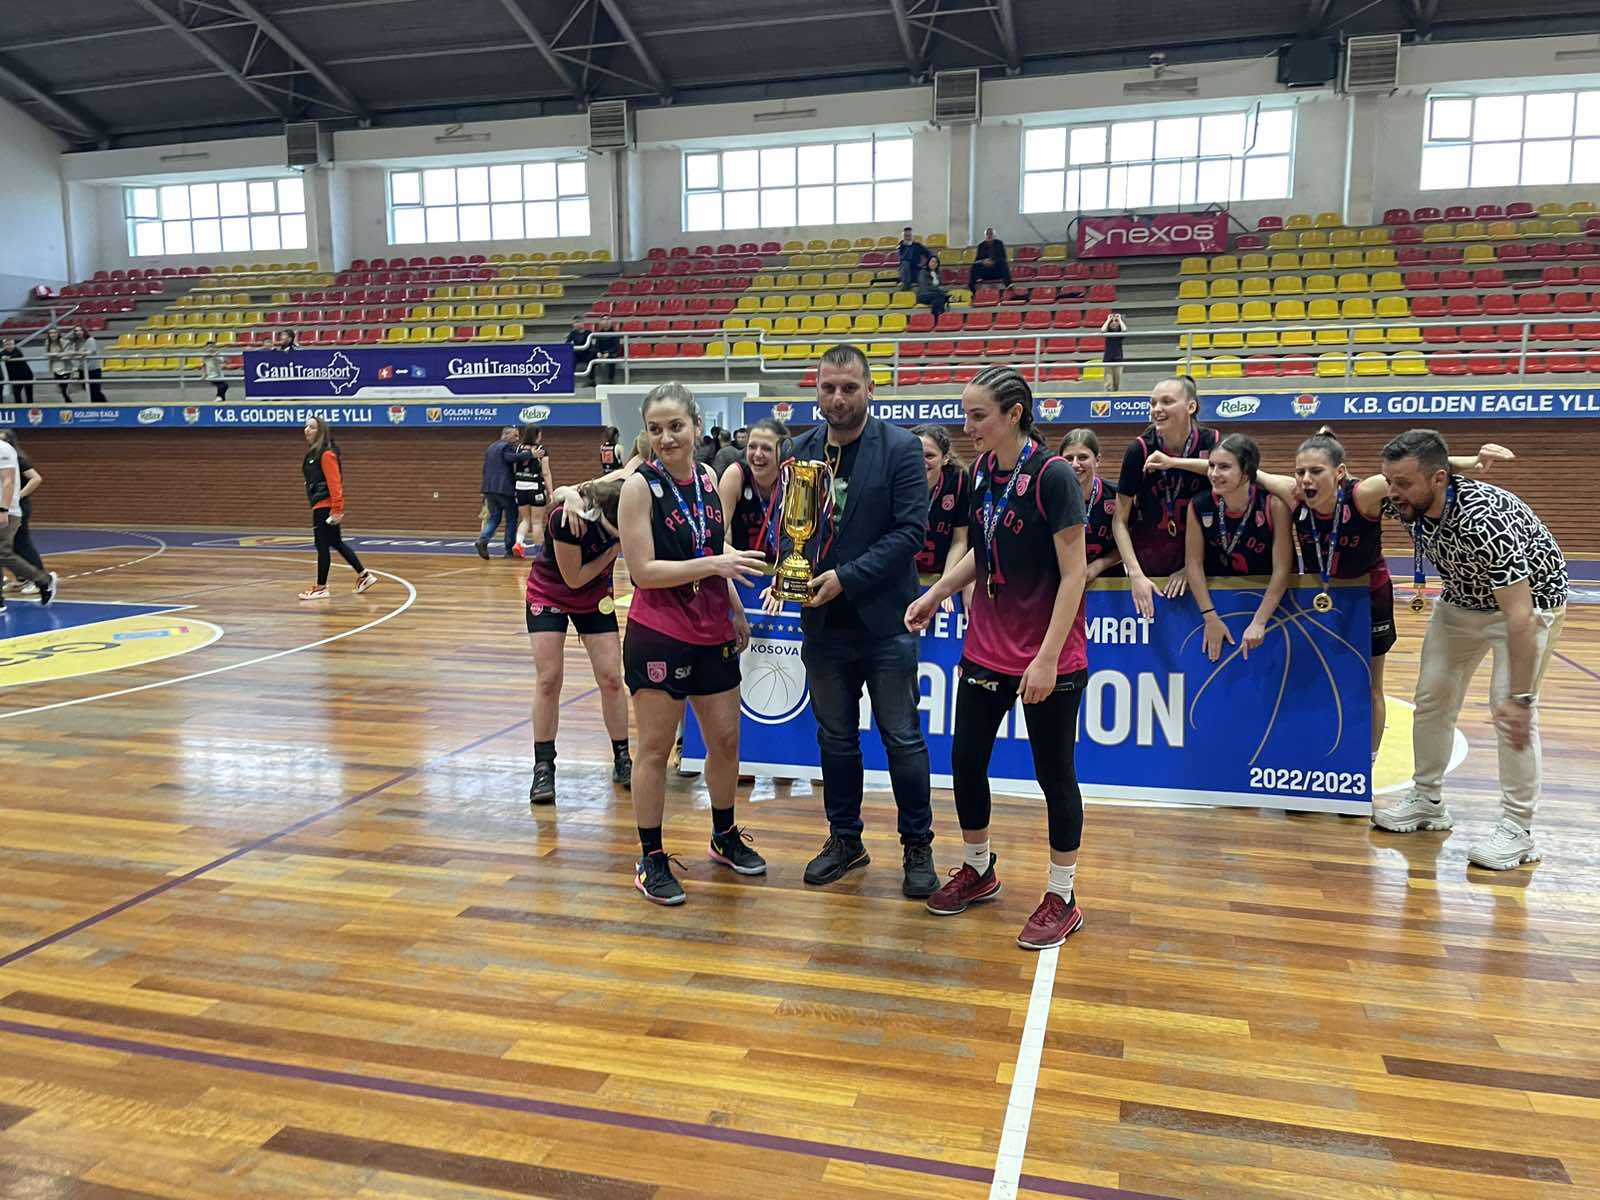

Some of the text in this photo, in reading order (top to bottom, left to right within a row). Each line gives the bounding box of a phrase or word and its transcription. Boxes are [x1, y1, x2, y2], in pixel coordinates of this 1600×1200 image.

[1107, 224, 1214, 244] nexos
[443, 407, 498, 416] GOLDEN EAGLE
[867, 403, 967, 420] LDEN EAGL
[1221, 401, 1255, 413] Relax
[1344, 394, 1600, 413] K.B. GOLDEN EAGLE YLL
[214, 408, 238, 422] K.B.
[240, 408, 299, 422] GOLDEN
[343, 408, 372, 422] YLLI
[1084, 616, 1155, 644] MRAT
[750, 644, 799, 657] KOSOVA
[1250, 767, 1367, 795] 2022/2023
